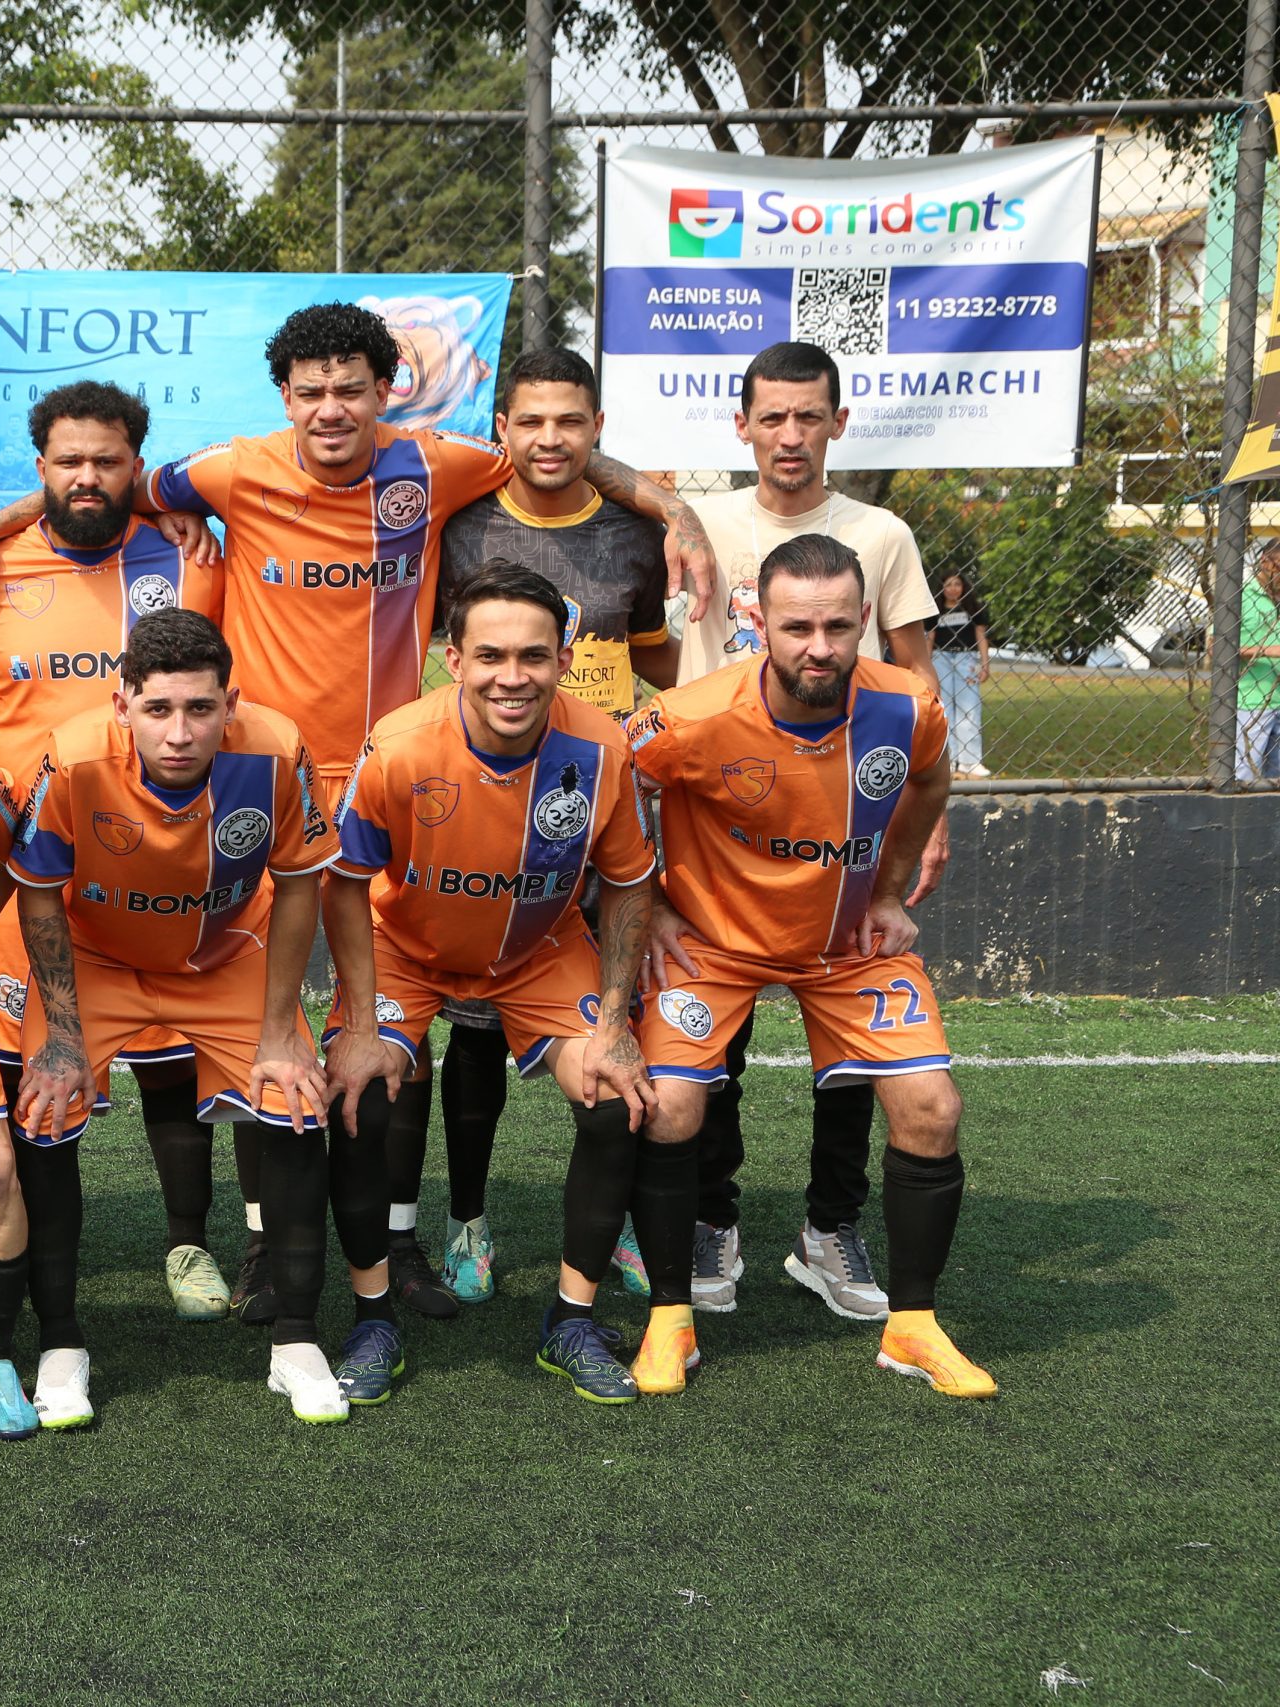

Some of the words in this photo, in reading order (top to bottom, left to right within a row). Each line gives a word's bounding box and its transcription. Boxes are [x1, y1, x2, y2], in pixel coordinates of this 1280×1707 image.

[757, 190, 1026, 235] Sorridents
[754, 240, 853, 258] simples
[870, 243, 933, 255] como
[950, 239, 1026, 254] sorrir
[647, 288, 721, 304] AGENDE
[725, 288, 762, 305] SUA
[895, 298, 920, 320] 11
[928, 295, 1057, 319] 93232-8778
[650, 312, 754, 334] AVALIAÇÃO
[757, 314, 763, 331] !
[658, 373, 744, 397] UNID
[852, 370, 1041, 396] DEMARCHI
[686, 407, 709, 421] AV
[857, 405, 943, 421] DEMARCHI
[948, 404, 988, 419] 1791
[848, 423, 935, 439] BRADESCO
[302, 552, 420, 589] BOMPIC
[769, 830, 882, 868] BOMPI
[127, 873, 260, 916] BOMPIC
[438, 867, 576, 901] BOMPIC
[855, 977, 930, 1033] 22
